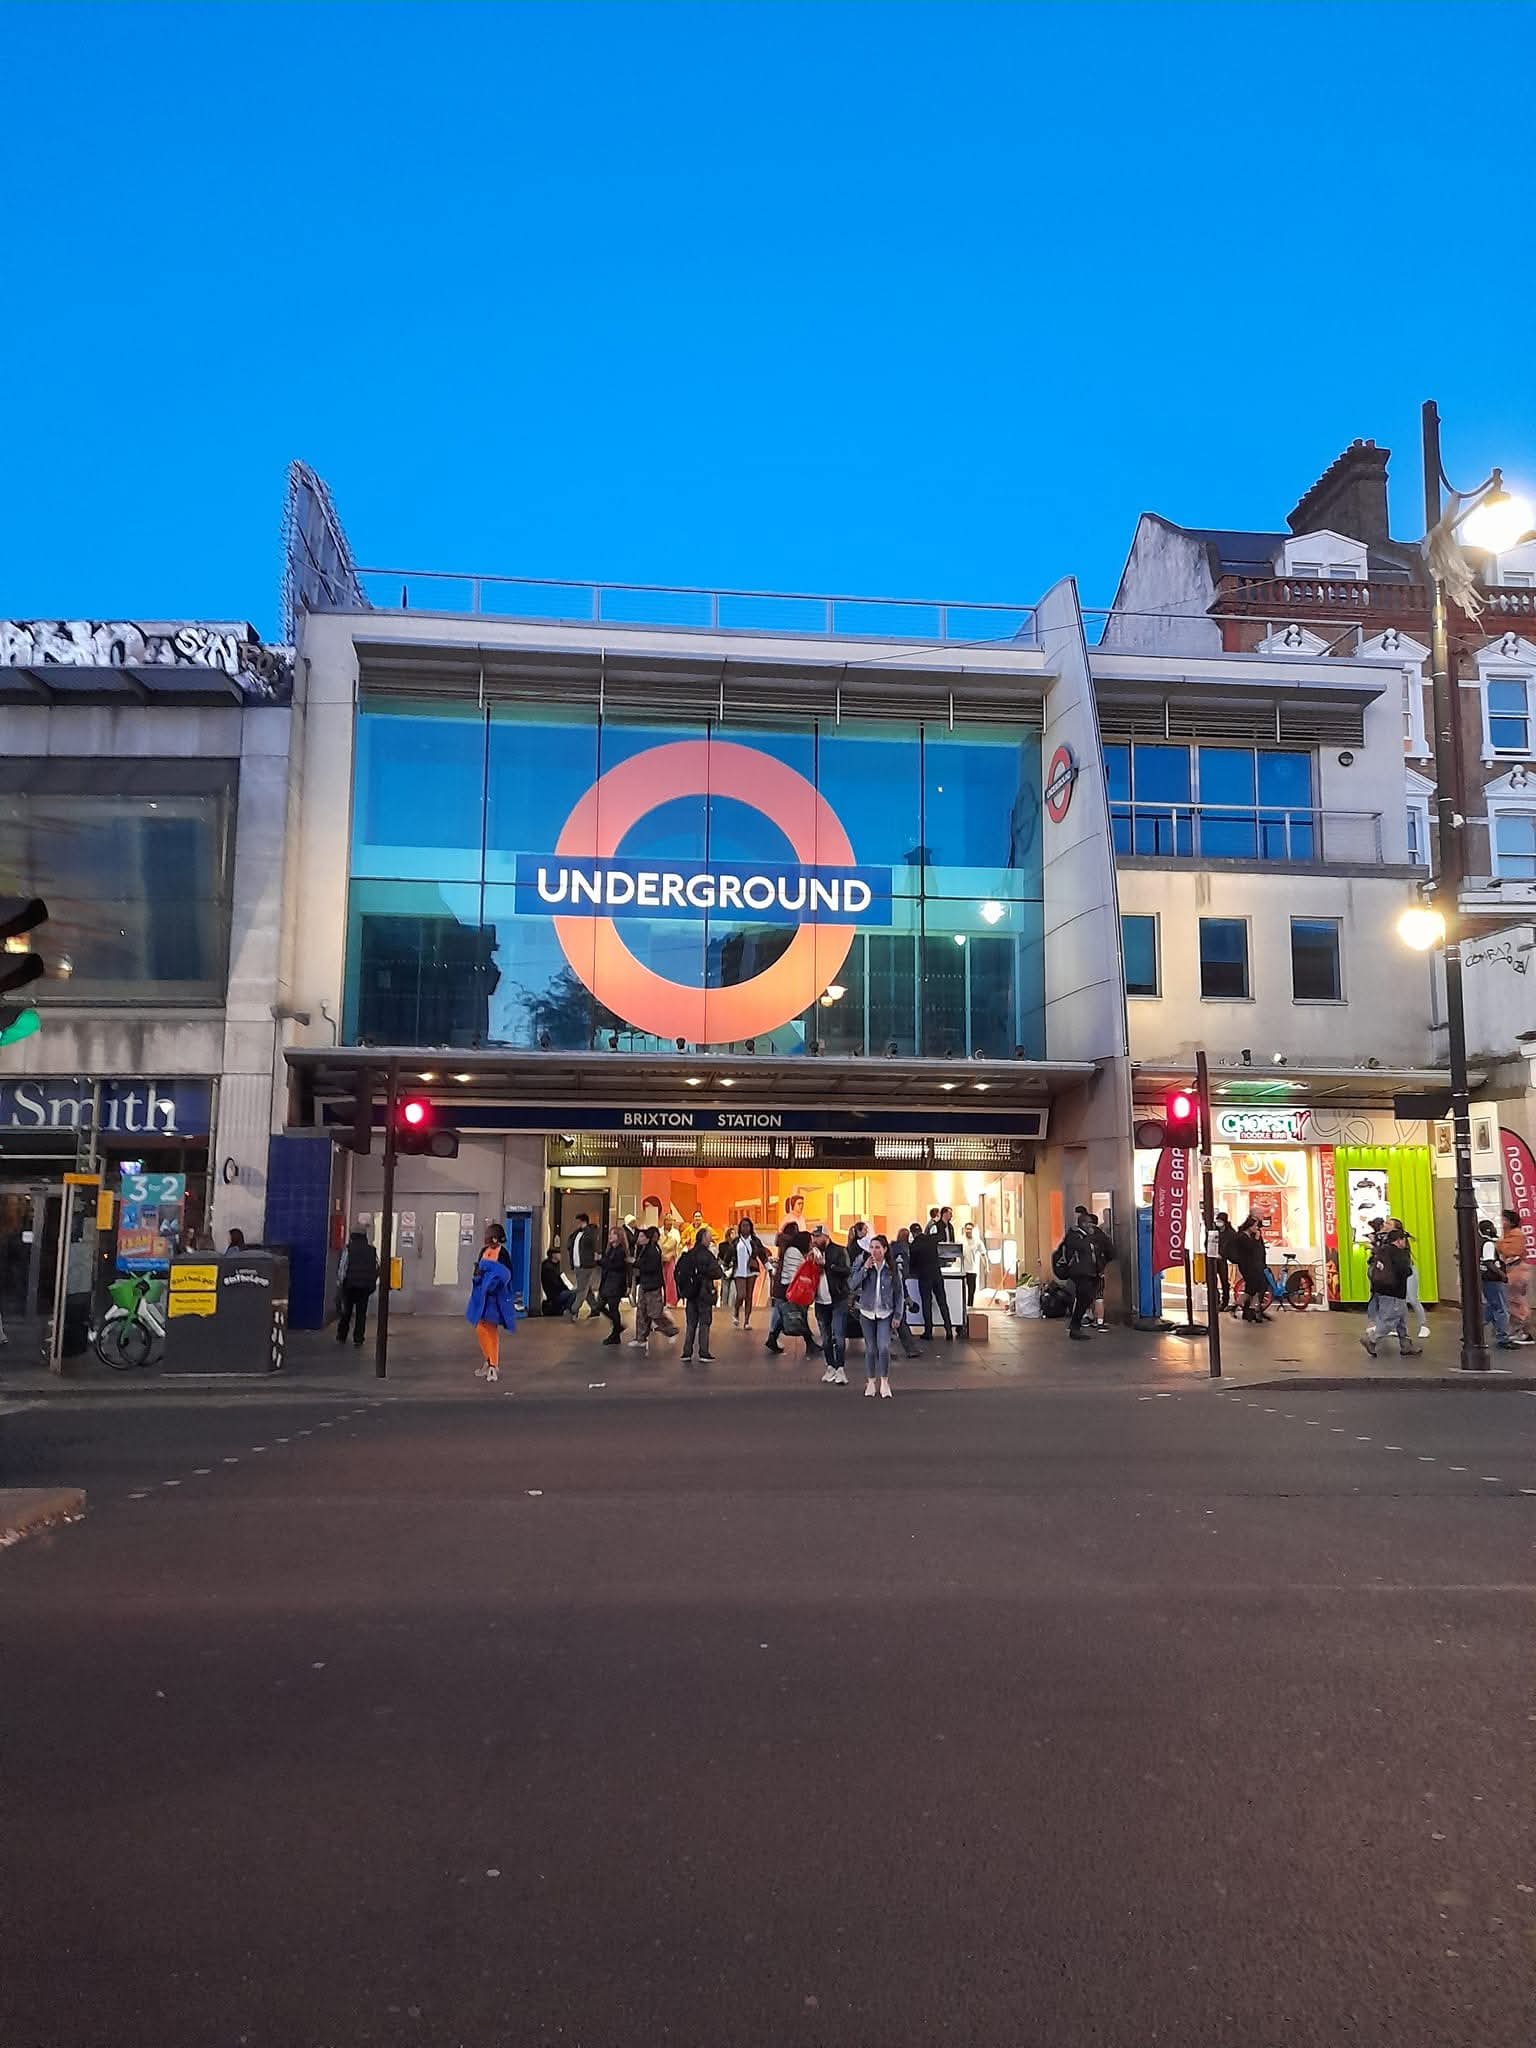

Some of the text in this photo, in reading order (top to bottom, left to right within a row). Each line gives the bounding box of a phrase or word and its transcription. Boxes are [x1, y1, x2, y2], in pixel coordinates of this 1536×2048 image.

[537, 868, 872, 912] UNDERGROUND
[12, 1082, 178, 1132] Smith
[623, 1112, 782, 1128] BRIXTON STATION
[129, 1175, 148, 1201] 3
[160, 1175, 178, 1201] 2
[1506, 1145, 1531, 1218] NOODLE
[1169, 1186, 1184, 1261] NOODLE
